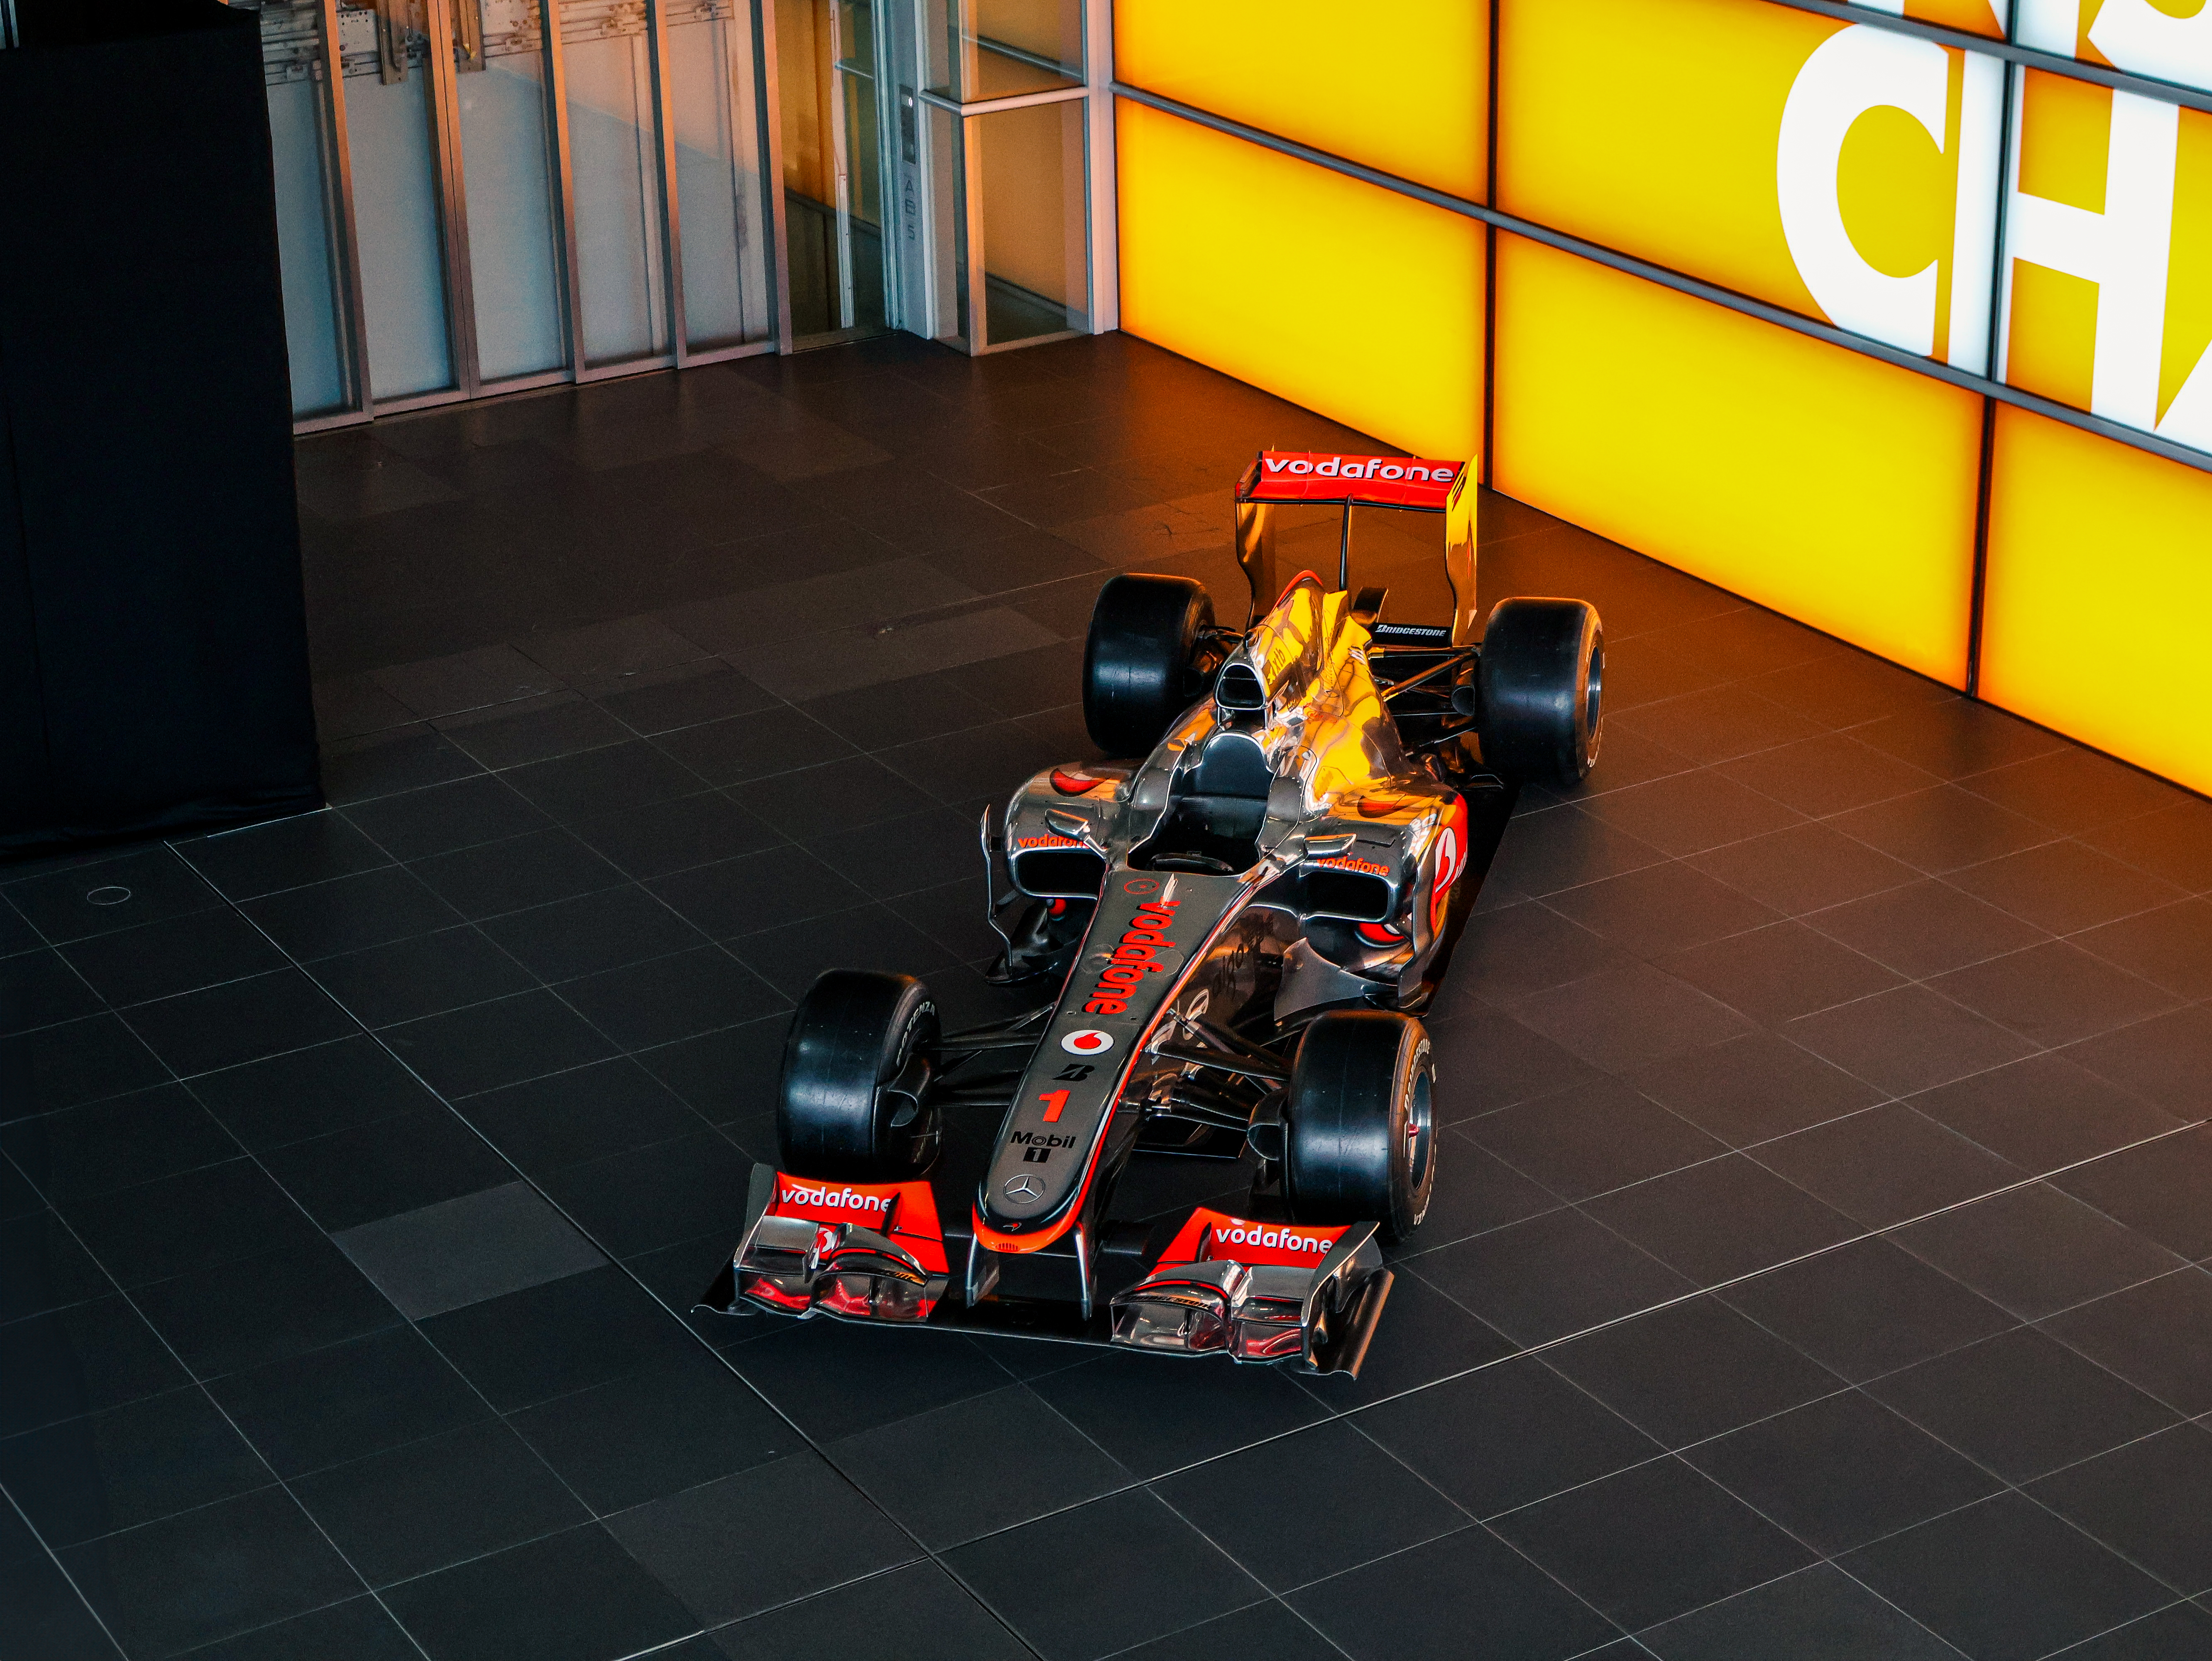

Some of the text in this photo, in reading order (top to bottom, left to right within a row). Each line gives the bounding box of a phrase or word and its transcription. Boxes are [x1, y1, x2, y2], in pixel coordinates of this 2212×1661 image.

[1776, 23, 2212, 456] CH
[1265, 457, 1454, 482] vodafone
[1375, 624, 1446, 637] BRIDGESTONE
[1316, 855, 1390, 877] vodafone
[1084, 900, 1181, 1014] vodafone
[1039, 1089, 1070, 1122] 1
[1010, 1131, 1076, 1149] Mobil
[1216, 1225, 1333, 1254] vodafone
